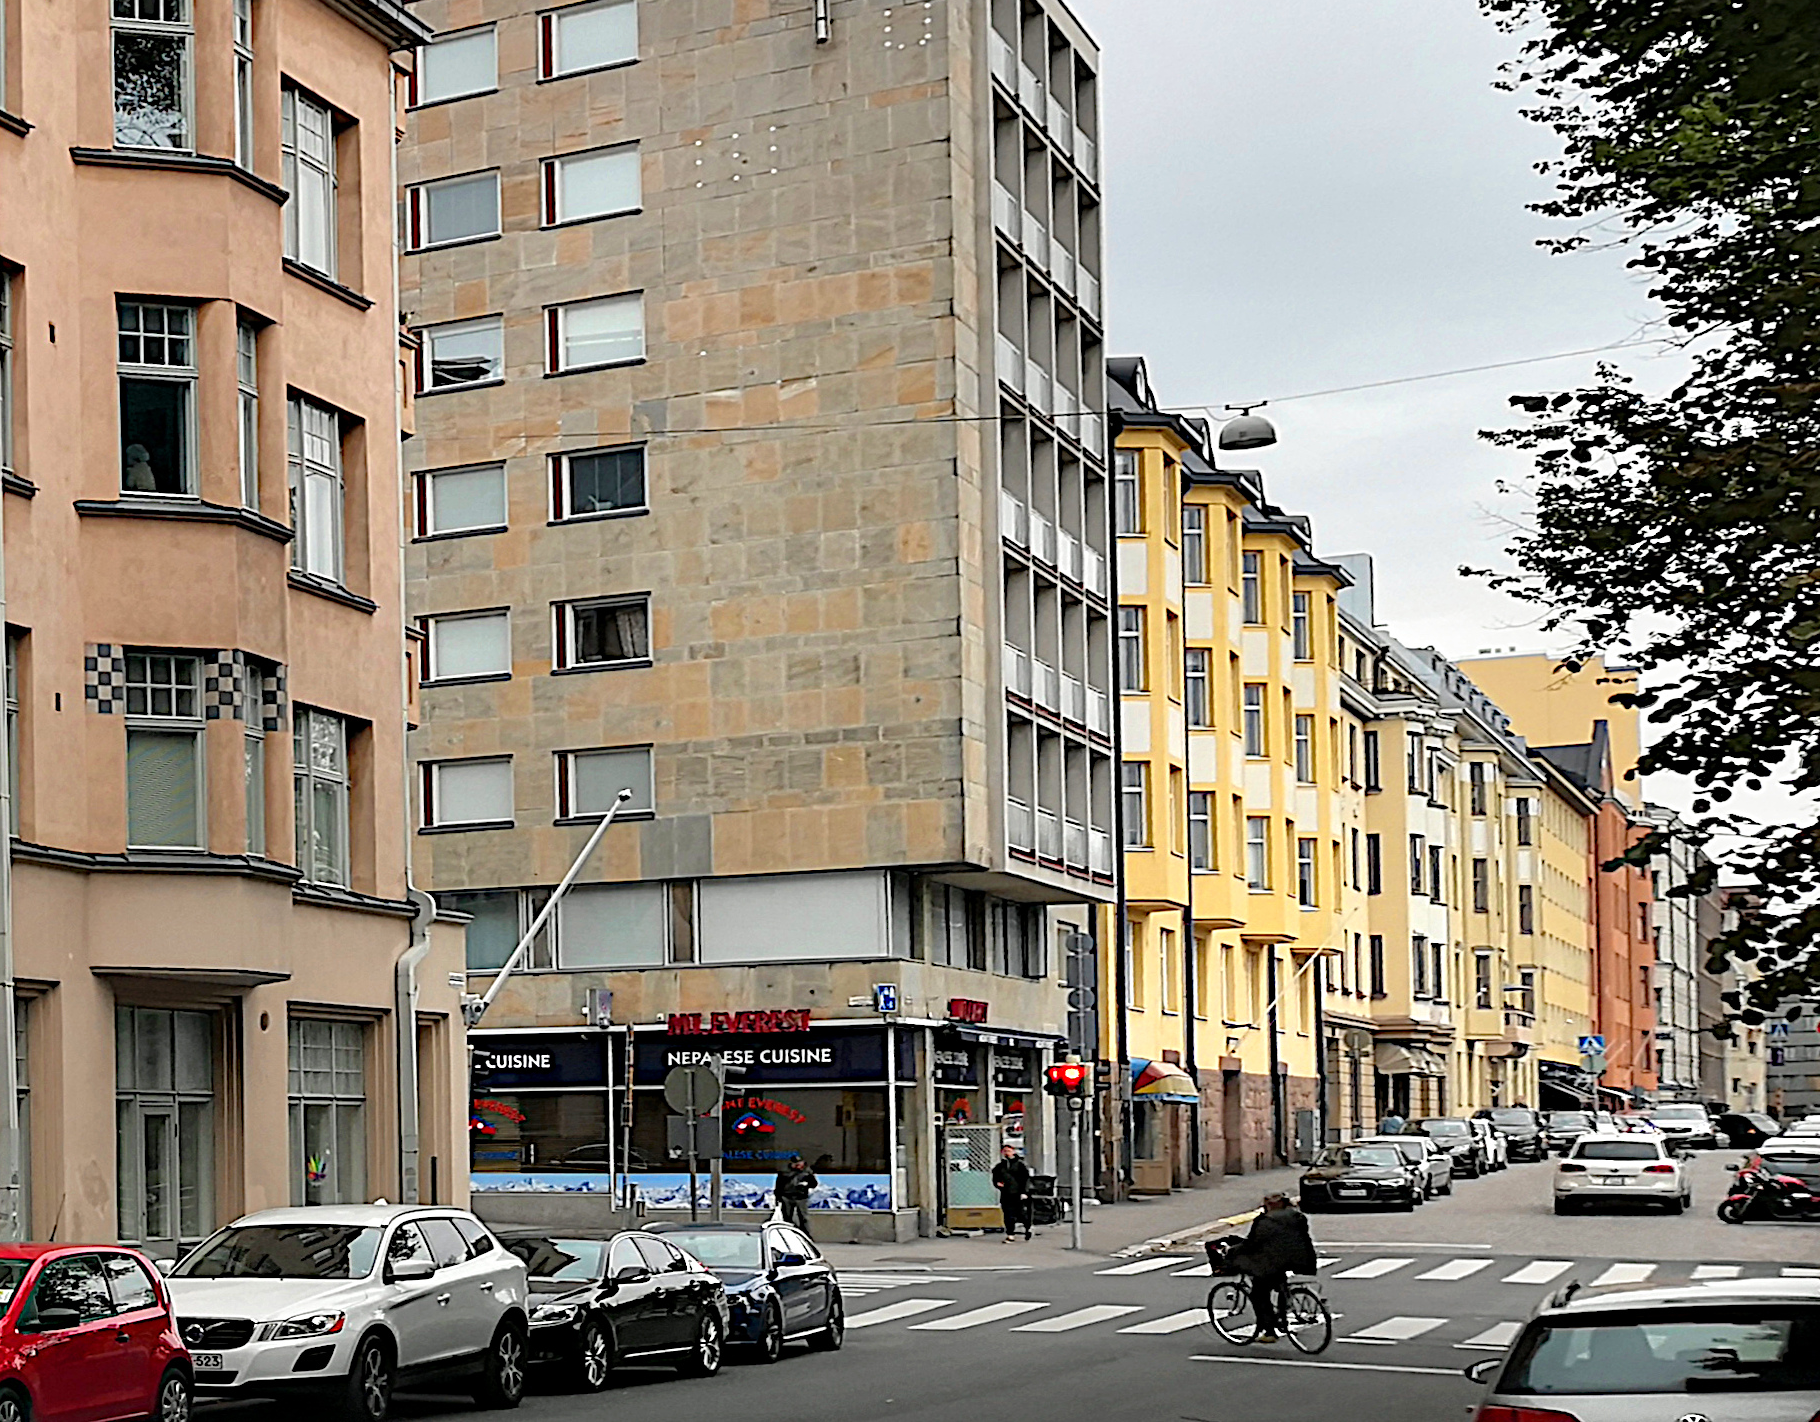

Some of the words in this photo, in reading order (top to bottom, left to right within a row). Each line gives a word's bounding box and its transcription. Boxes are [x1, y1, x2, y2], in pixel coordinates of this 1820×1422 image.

[710, 1009, 811, 1034] EVEREST
[486, 1054, 551, 1069] CUISINE
[760, 1048, 832, 1064] CUISINE
[193, 1355, 220, 1367] -523
